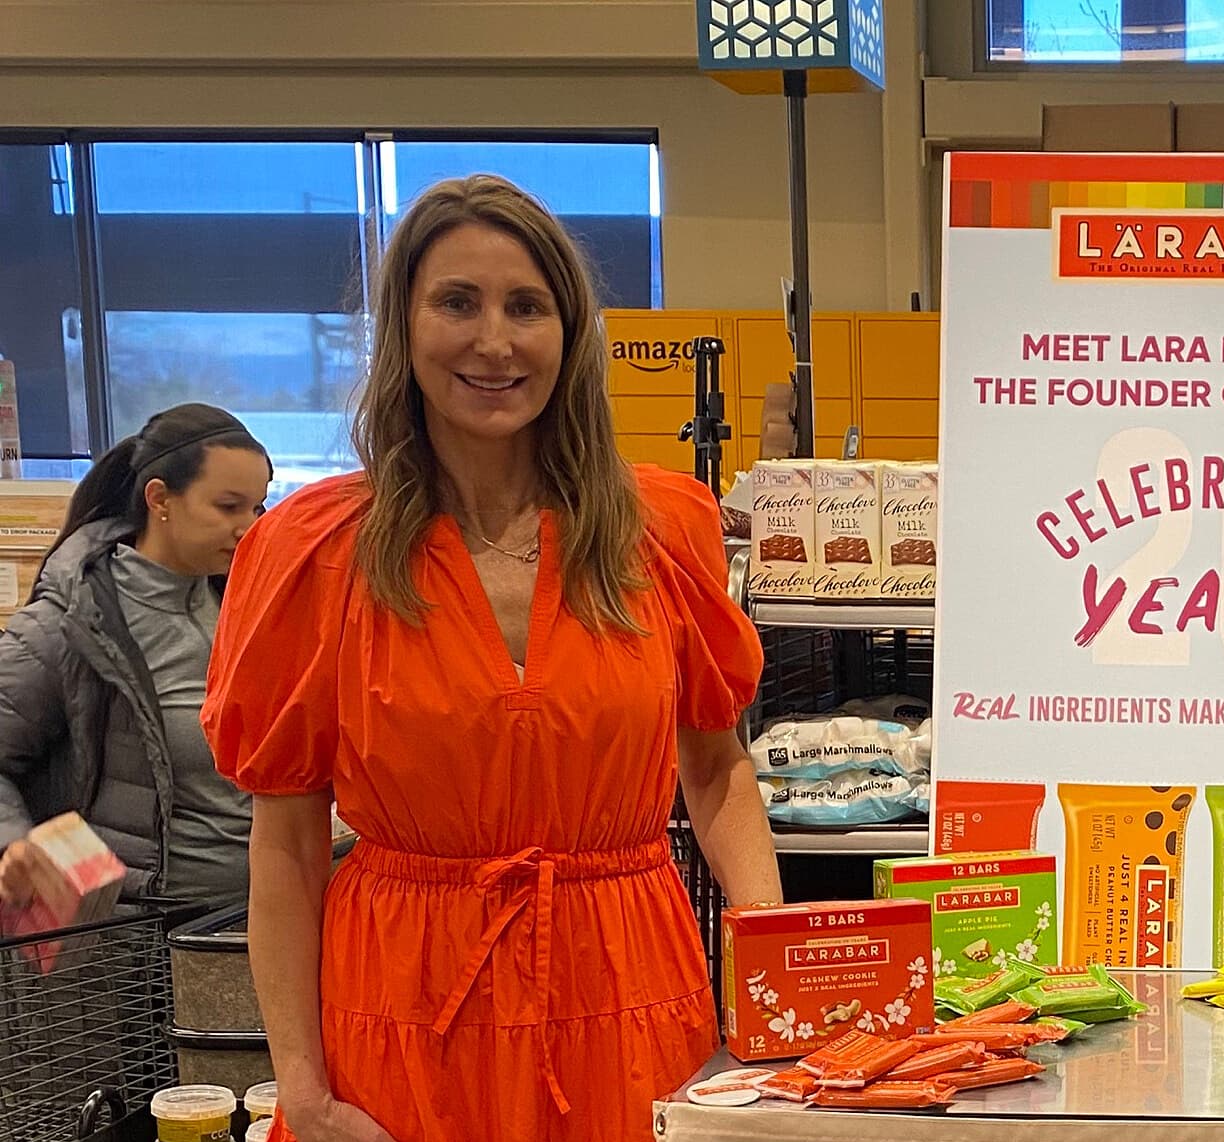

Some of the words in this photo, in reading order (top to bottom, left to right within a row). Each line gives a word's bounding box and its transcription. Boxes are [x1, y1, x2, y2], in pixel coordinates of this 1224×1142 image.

[612, 339, 694, 360] amazo
[1023, 334, 1110, 361] MEET
[1122, 336, 1210, 363] LARA
[974, 377, 1036, 405] THE
[1048, 379, 1210, 408] FOUNDER
[753, 492, 813, 512] Chocolove
[817, 494, 876, 514] Chocolove
[767, 517, 796, 527] Milk
[831, 518, 860, 529] Milk
[898, 520, 926, 531] Milk
[814, 572, 879, 594] Chocolove
[953, 692, 1020, 721] REAL
[1029, 696, 1171, 725] INGREDIENTS
[770, 750, 786, 760] 365
[792, 749, 821, 759] Large
[823, 744, 893, 756] Marshmallows
[794, 789, 824, 799] Large
[826, 780, 893, 800] Marshmallows
[955, 812, 964, 823] NET
[955, 824, 964, 837] WT
[953, 866, 964, 875] 12
[969, 864, 999, 874] BARS
[1120, 854, 1130, 888] JUST
[808, 916, 822, 927] 12
[828, 913, 865, 925] BARS
[958, 917, 981, 925] APPLE
[1105, 908, 1113, 944] BUTTER
[1119, 909, 1128, 944] REAL
[800, 975, 839, 983] CASHEW
[843, 972, 877, 980] COOKIE
[749, 1035, 765, 1049] 12
